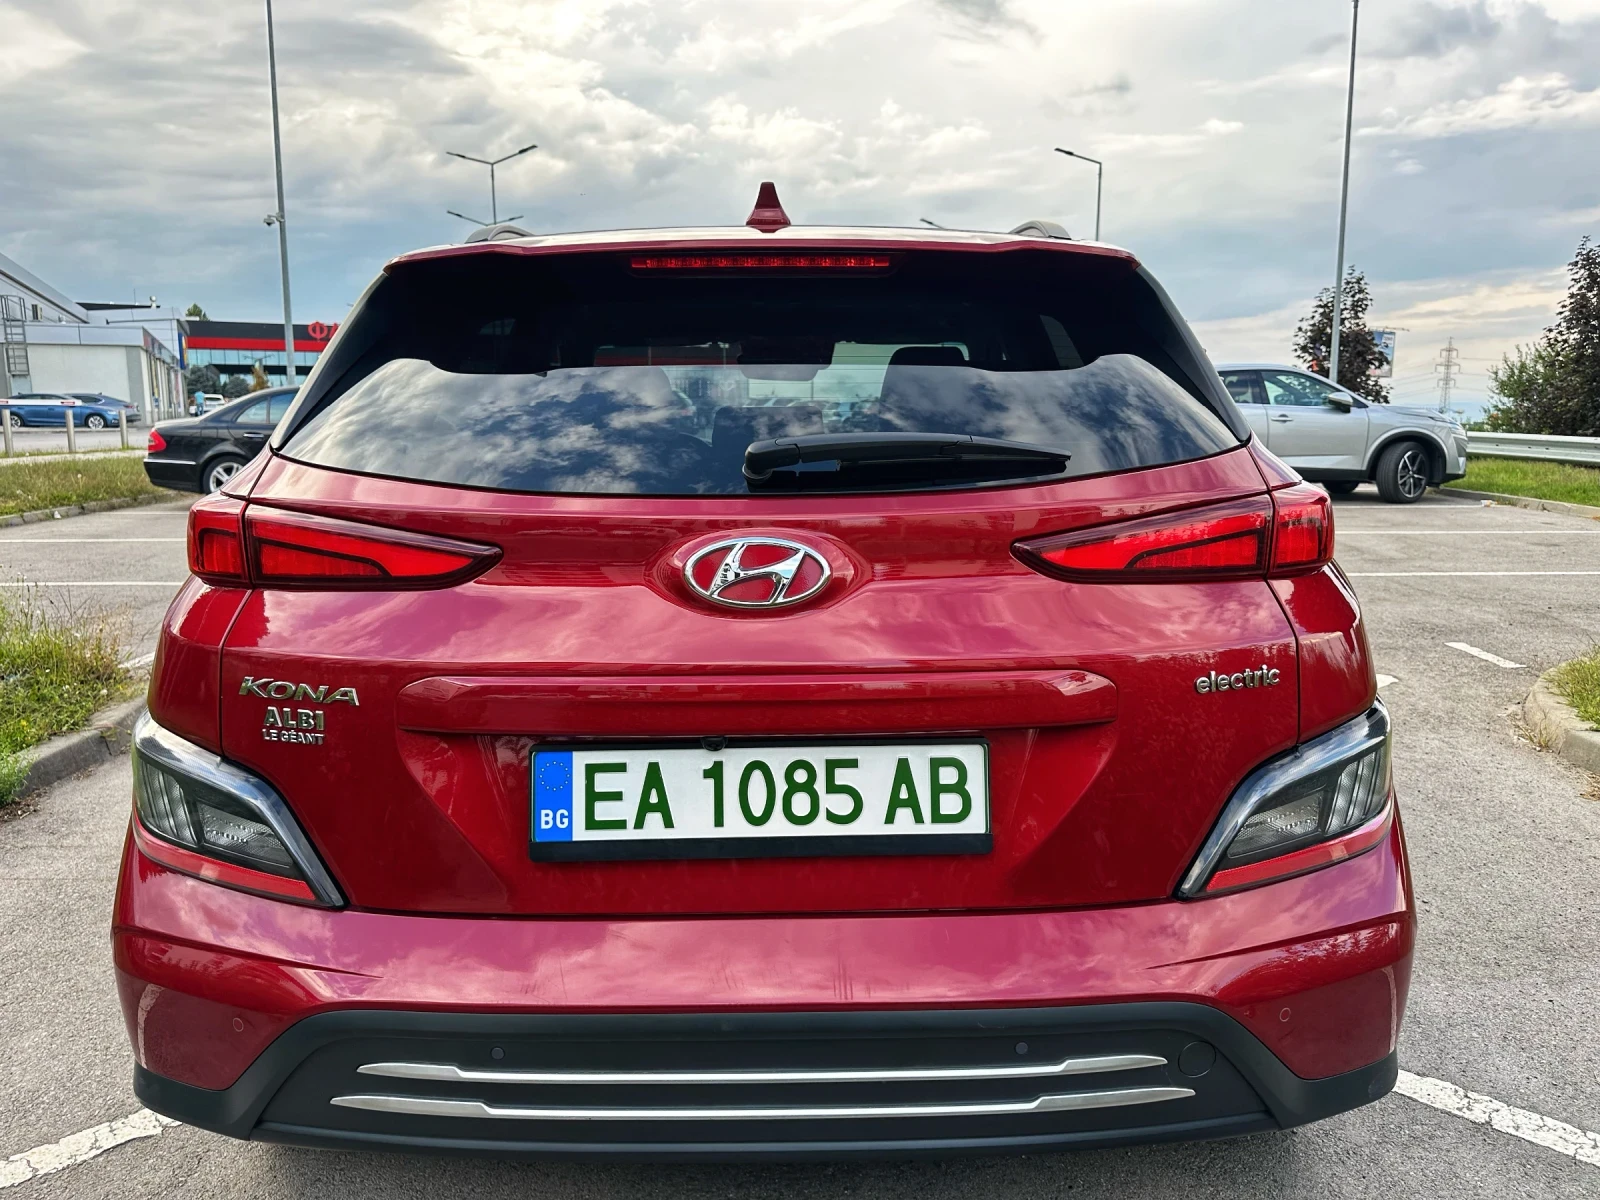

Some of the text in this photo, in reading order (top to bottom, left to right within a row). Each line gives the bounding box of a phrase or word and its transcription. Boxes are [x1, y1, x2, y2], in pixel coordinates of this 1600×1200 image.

[239, 676, 360, 706] KONA
[1195, 664, 1281, 694] electric
[264, 706, 325, 730] ALBI
[262, 729, 325, 745] LE GÉANT
[584, 756, 973, 830] EA 1085 AB
[540, 808, 569, 830] BG
